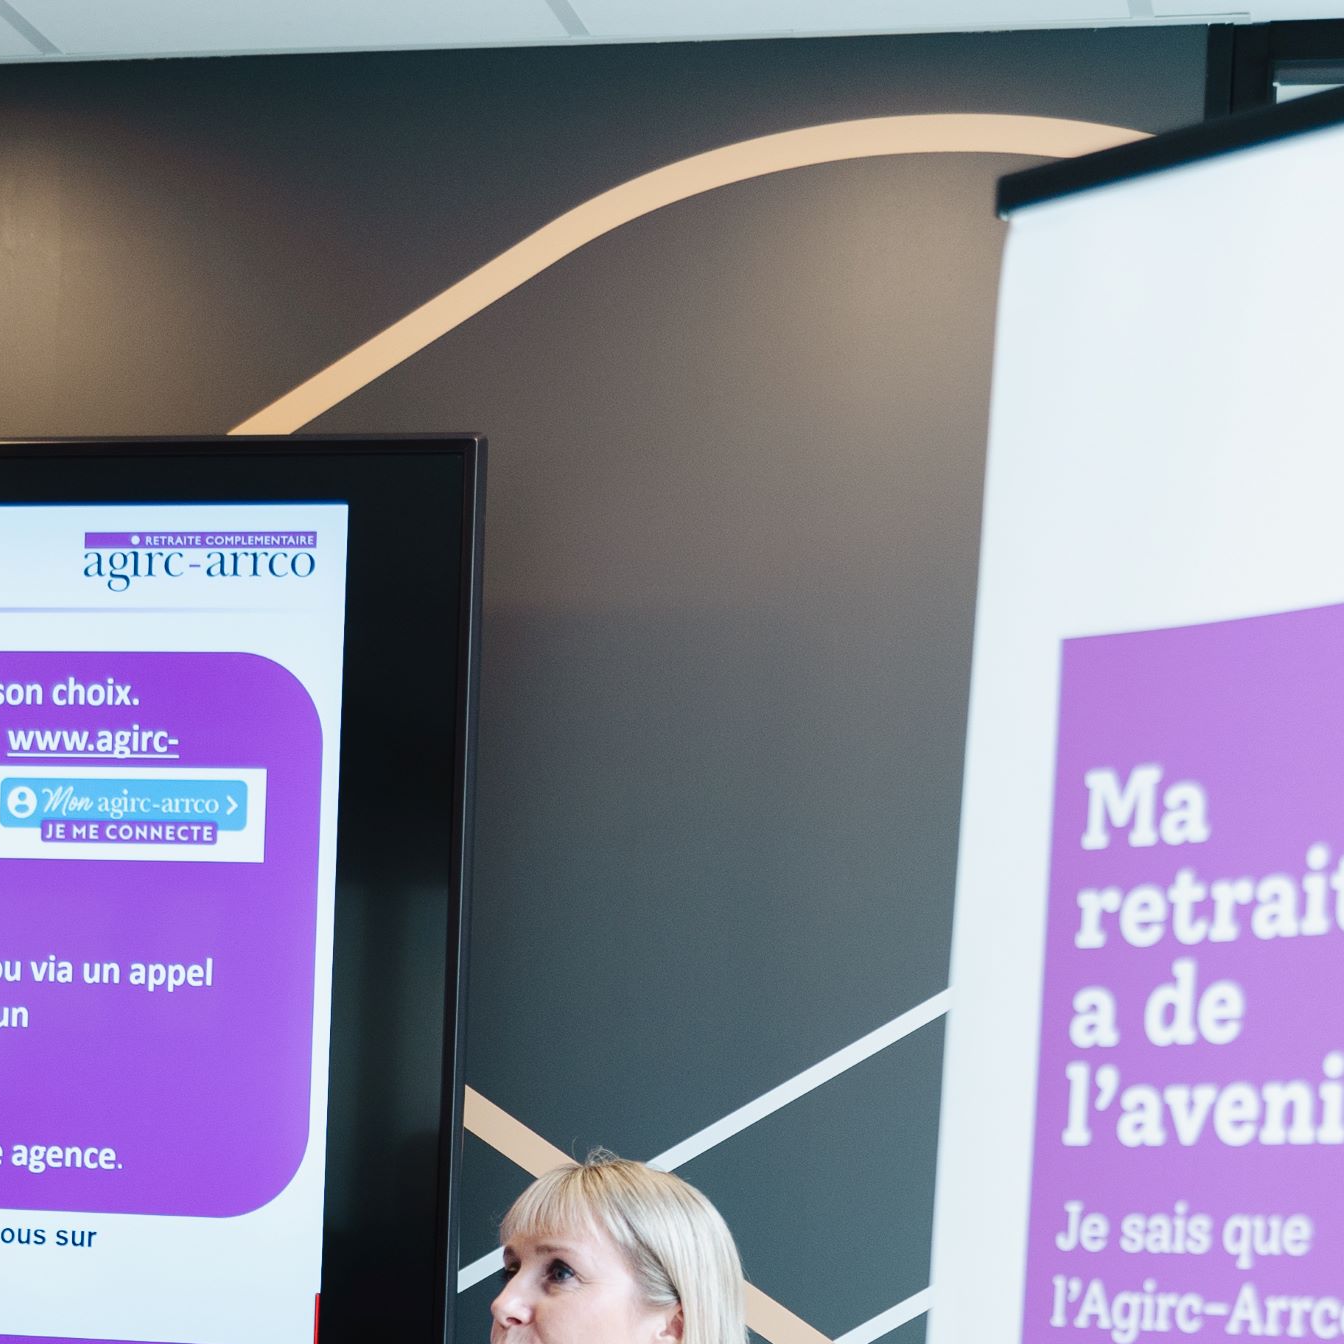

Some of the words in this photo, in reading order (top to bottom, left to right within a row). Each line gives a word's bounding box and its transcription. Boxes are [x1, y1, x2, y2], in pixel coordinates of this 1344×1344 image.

[145, 536, 202, 545] RETRAITE
[207, 536, 314, 545] COMPLEMENTAIRE
[83, 550, 316, 592] agirc-arrco
[51, 676, 140, 707] choix.
[8, 728, 178, 758] www.agirc-
[42, 787, 92, 813] Mon
[97, 788, 220, 820] agirc-arrco
[1081, 764, 1210, 850] Ma
[44, 824, 67, 840] JE
[73, 824, 100, 840] ME
[106, 824, 213, 841] CONNECTE
[30, 954, 73, 984] via
[83, 962, 120, 984] un
[129, 957, 213, 993] appel
[1069, 987, 1120, 1049] a
[1144, 957, 1245, 1047] de
[11, 1144, 123, 1174] agence.
[55, 1229, 97, 1248] sur
[1055, 1200, 1110, 1253] Je
[1119, 1201, 1213, 1255] sais
[1222, 1214, 1313, 1270] que
